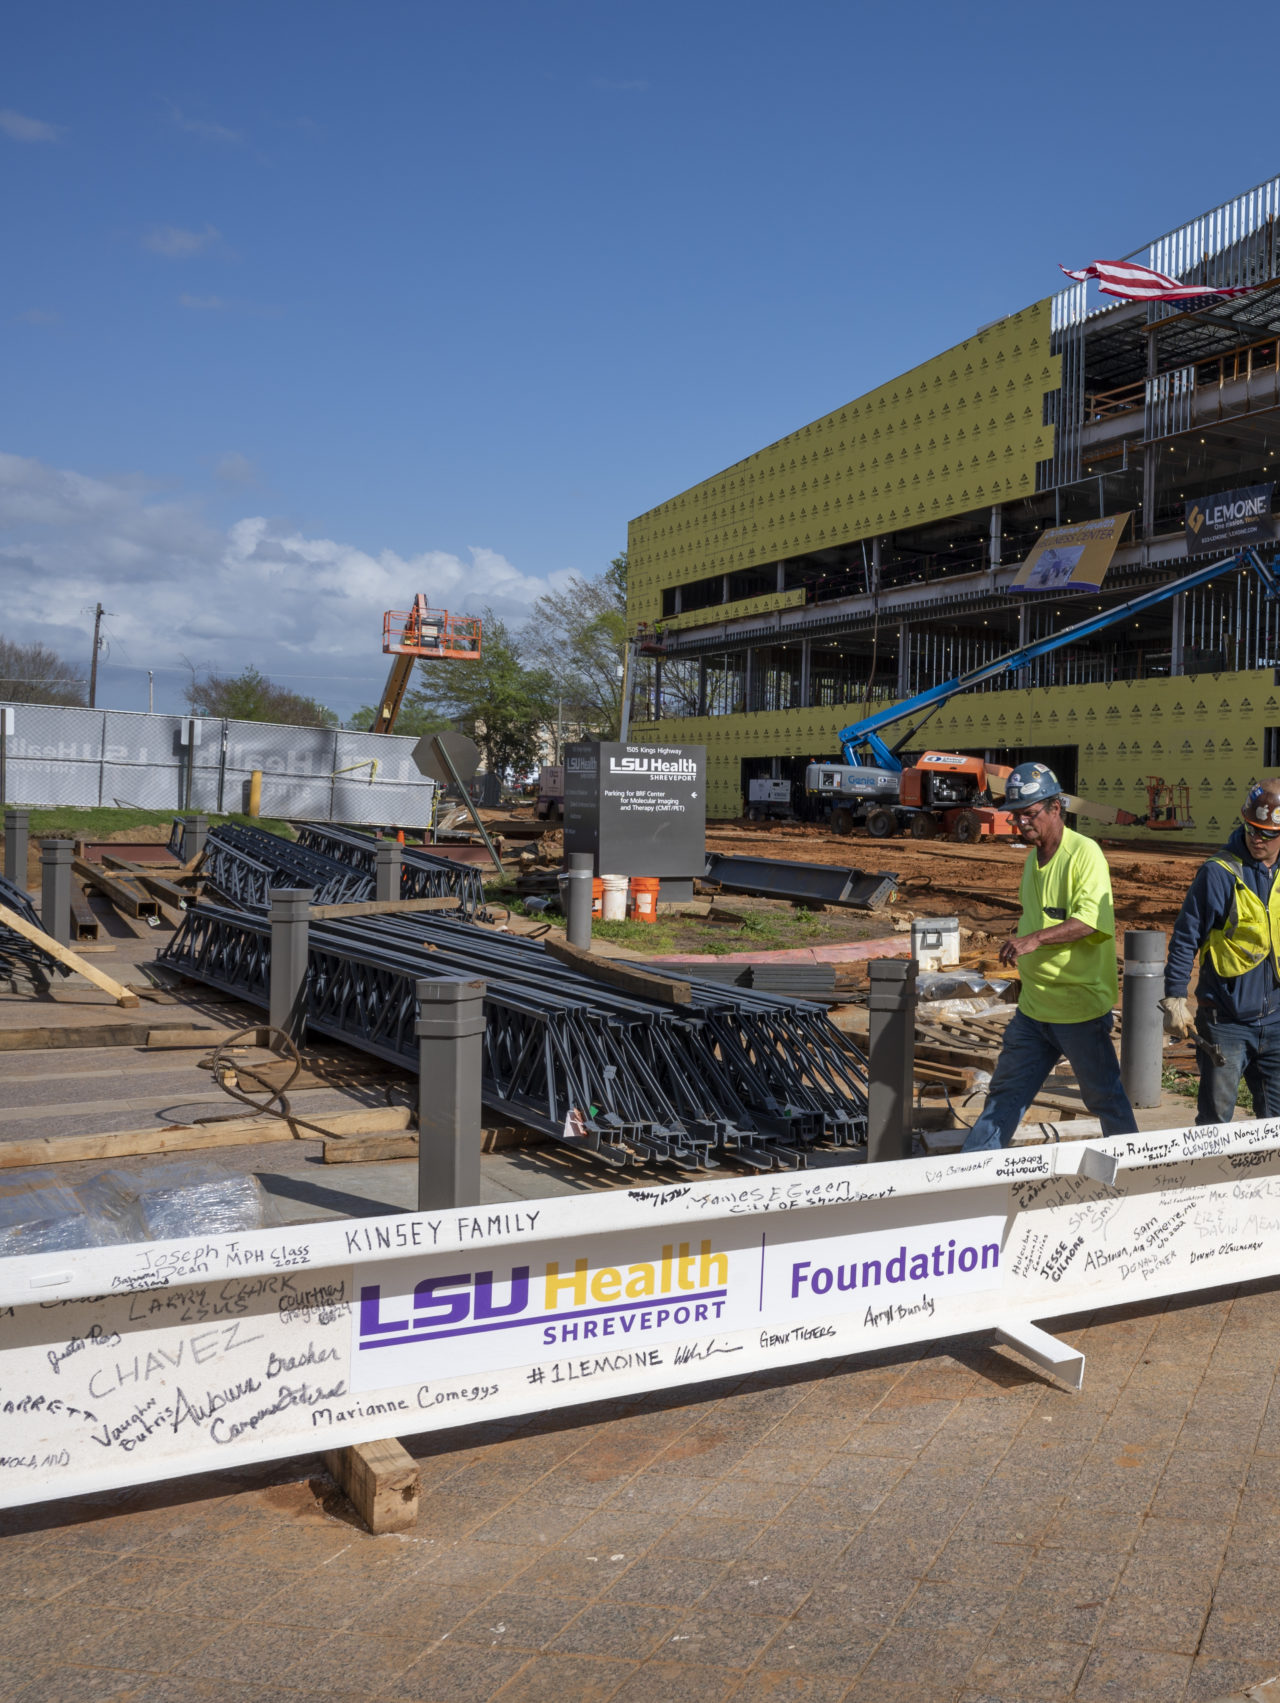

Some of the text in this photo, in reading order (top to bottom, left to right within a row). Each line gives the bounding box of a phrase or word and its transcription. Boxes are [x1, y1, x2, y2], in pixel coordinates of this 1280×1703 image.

[1205, 496, 1266, 526] LEMOINE
[640, 747, 656, 755] Kings
[610, 757, 697, 773] LSU Health
[848, 775, 875, 785] Genie
[657, 798, 679, 806] Imaging
[1182, 1133, 1231, 1157] CLENDENIN
[1183, 1126, 1219, 1144] MARGO
[1234, 1127, 1259, 1141] Nancy
[996, 1162, 1049, 1177] Samantha
[1004, 1154, 1042, 1167] Roberts
[787, 1180, 852, 1199] Green
[345, 1210, 541, 1255] KINSEY FAMILY
[1133, 1216, 1159, 1241] Sam
[133, 1244, 219, 1273] Joseph
[226, 1244, 310, 1268] MPH Class
[273, 1256, 311, 1268] 2022
[1039, 1240, 1068, 1280] JESSE
[1051, 1235, 1085, 1282] GILMORE
[791, 1239, 1000, 1299] Foundation
[128, 1286, 207, 1321] LARRY
[220, 1276, 298, 1301] CLARK
[279, 1280, 344, 1311] Courtney
[360, 1238, 730, 1337] LSU Health
[543, 1300, 727, 1346] SHREVEPORT
[791, 1325, 837, 1341] TIGERS
[88, 1321, 265, 1399] CHAVEZ
[0, 1394, 98, 1422] ARRETT
[312, 1382, 500, 1427] Marianne Comegys
